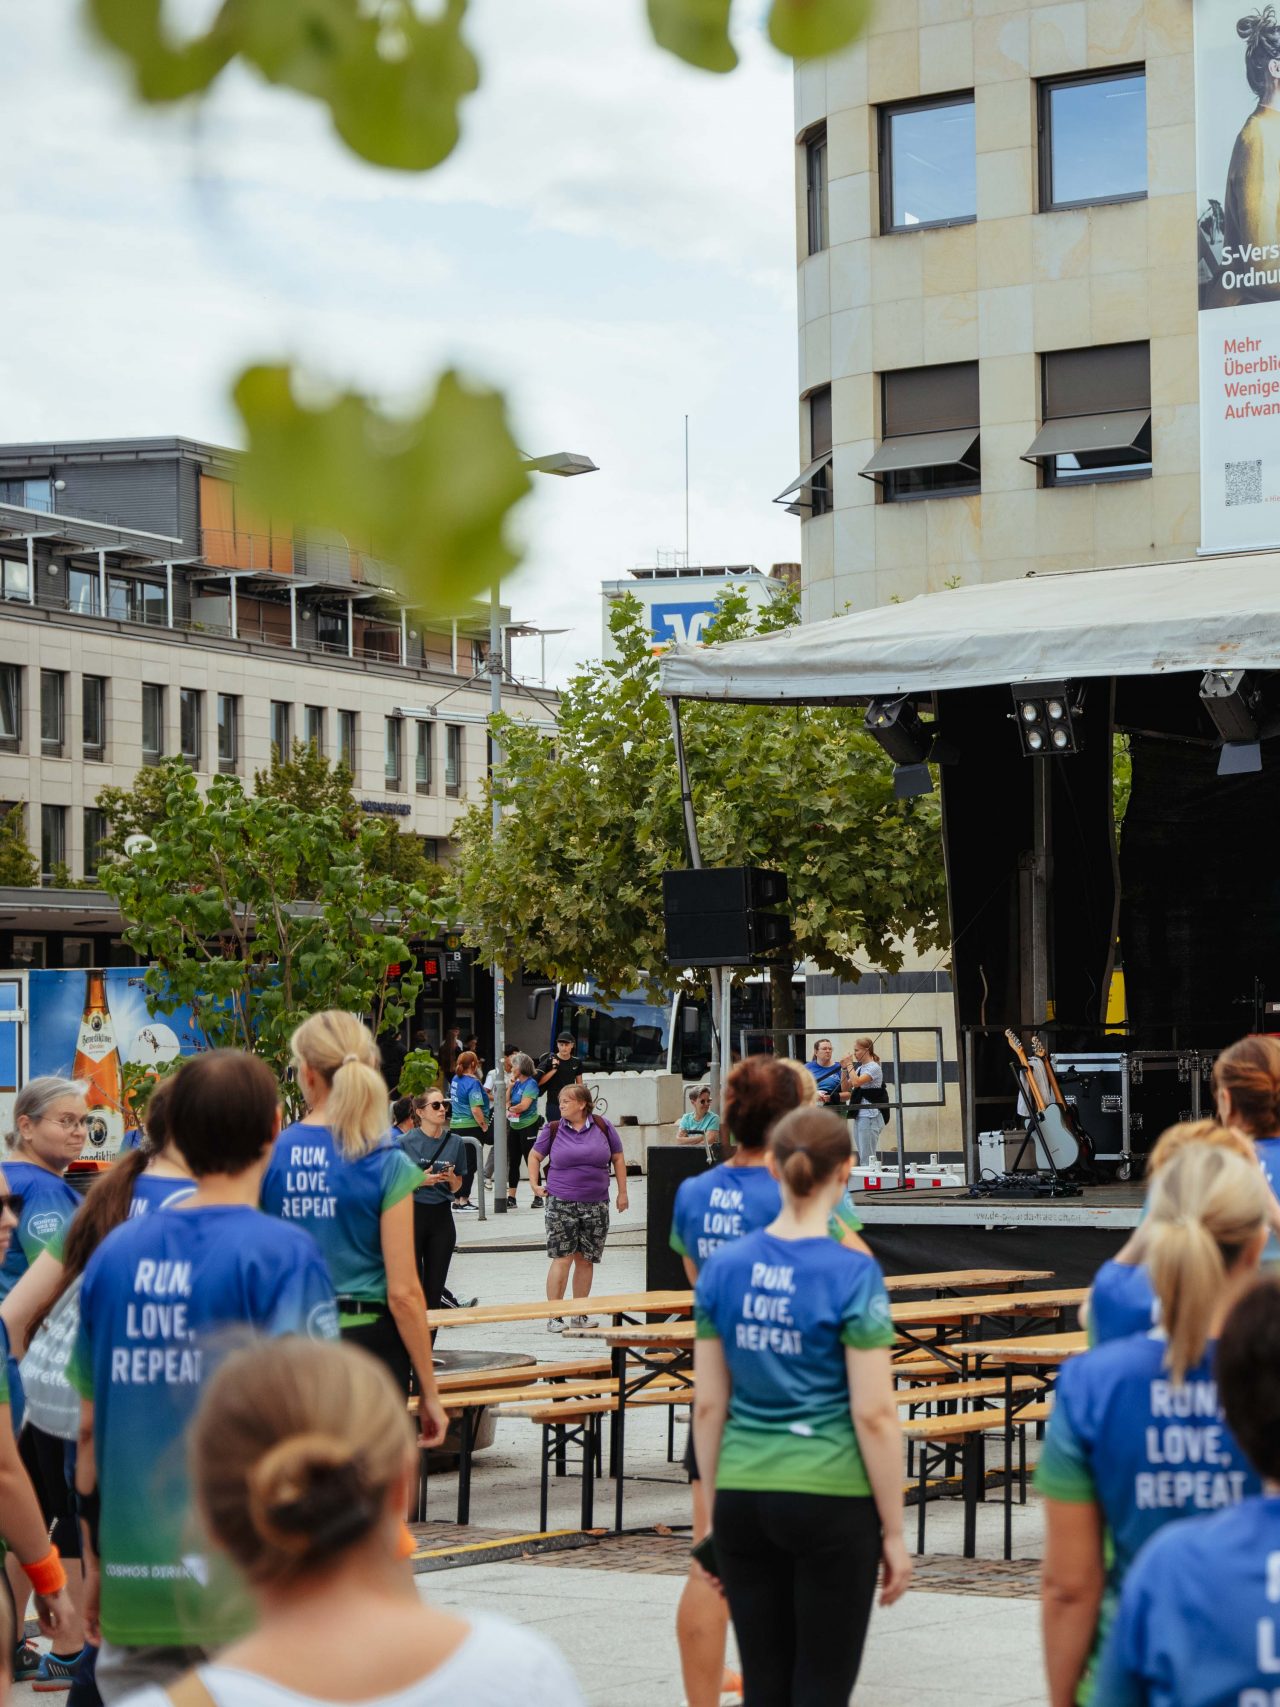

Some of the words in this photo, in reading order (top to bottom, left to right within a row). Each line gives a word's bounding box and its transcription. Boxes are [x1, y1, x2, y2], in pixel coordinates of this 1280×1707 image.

[1224, 336, 1262, 355] Mehr
[454, 952, 461, 961] B
[290, 1145, 330, 1168] RUN,
[286, 1171, 329, 1194] LOVE,
[281, 1196, 337, 1218] REPEAT
[709, 1187, 744, 1212] RUN,
[134, 1257, 193, 1298] RUN,
[751, 1262, 796, 1294] RUN,
[126, 1302, 196, 1342] LOVE,
[742, 1293, 794, 1327] LOVE,
[735, 1323, 803, 1355] REPEAT
[1150, 1378, 1226, 1421] RUN,
[1145, 1425, 1232, 1468] LOVE,
[1135, 1470, 1247, 1509] REPEAT
